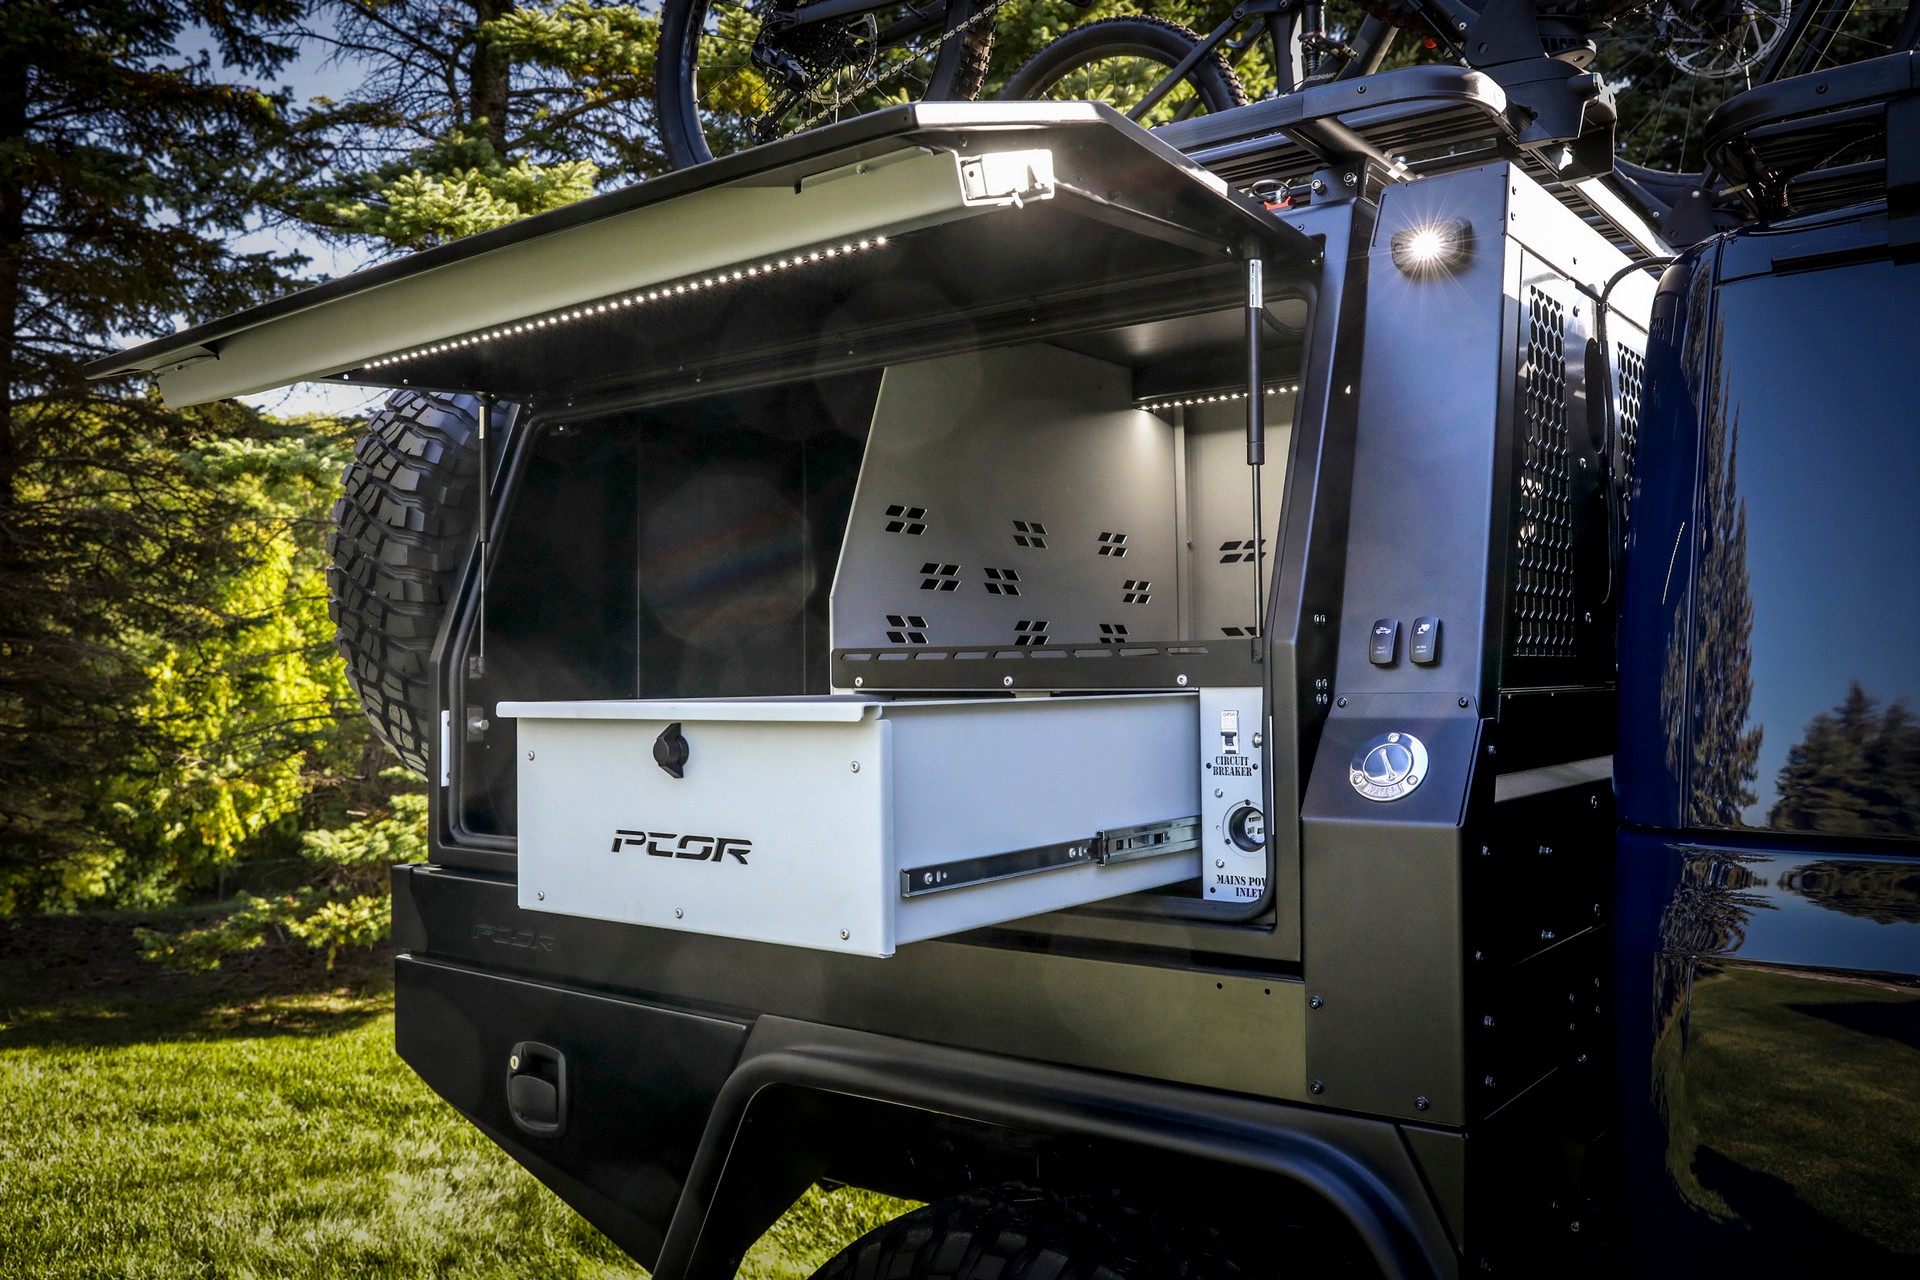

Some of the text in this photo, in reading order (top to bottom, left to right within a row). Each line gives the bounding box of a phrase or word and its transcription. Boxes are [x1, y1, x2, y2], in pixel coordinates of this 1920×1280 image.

[1215, 755, 1249, 766] CIRCUIT
[1212, 765, 1252, 777] BREAKER
[1216, 874, 1246, 886] MAINS
